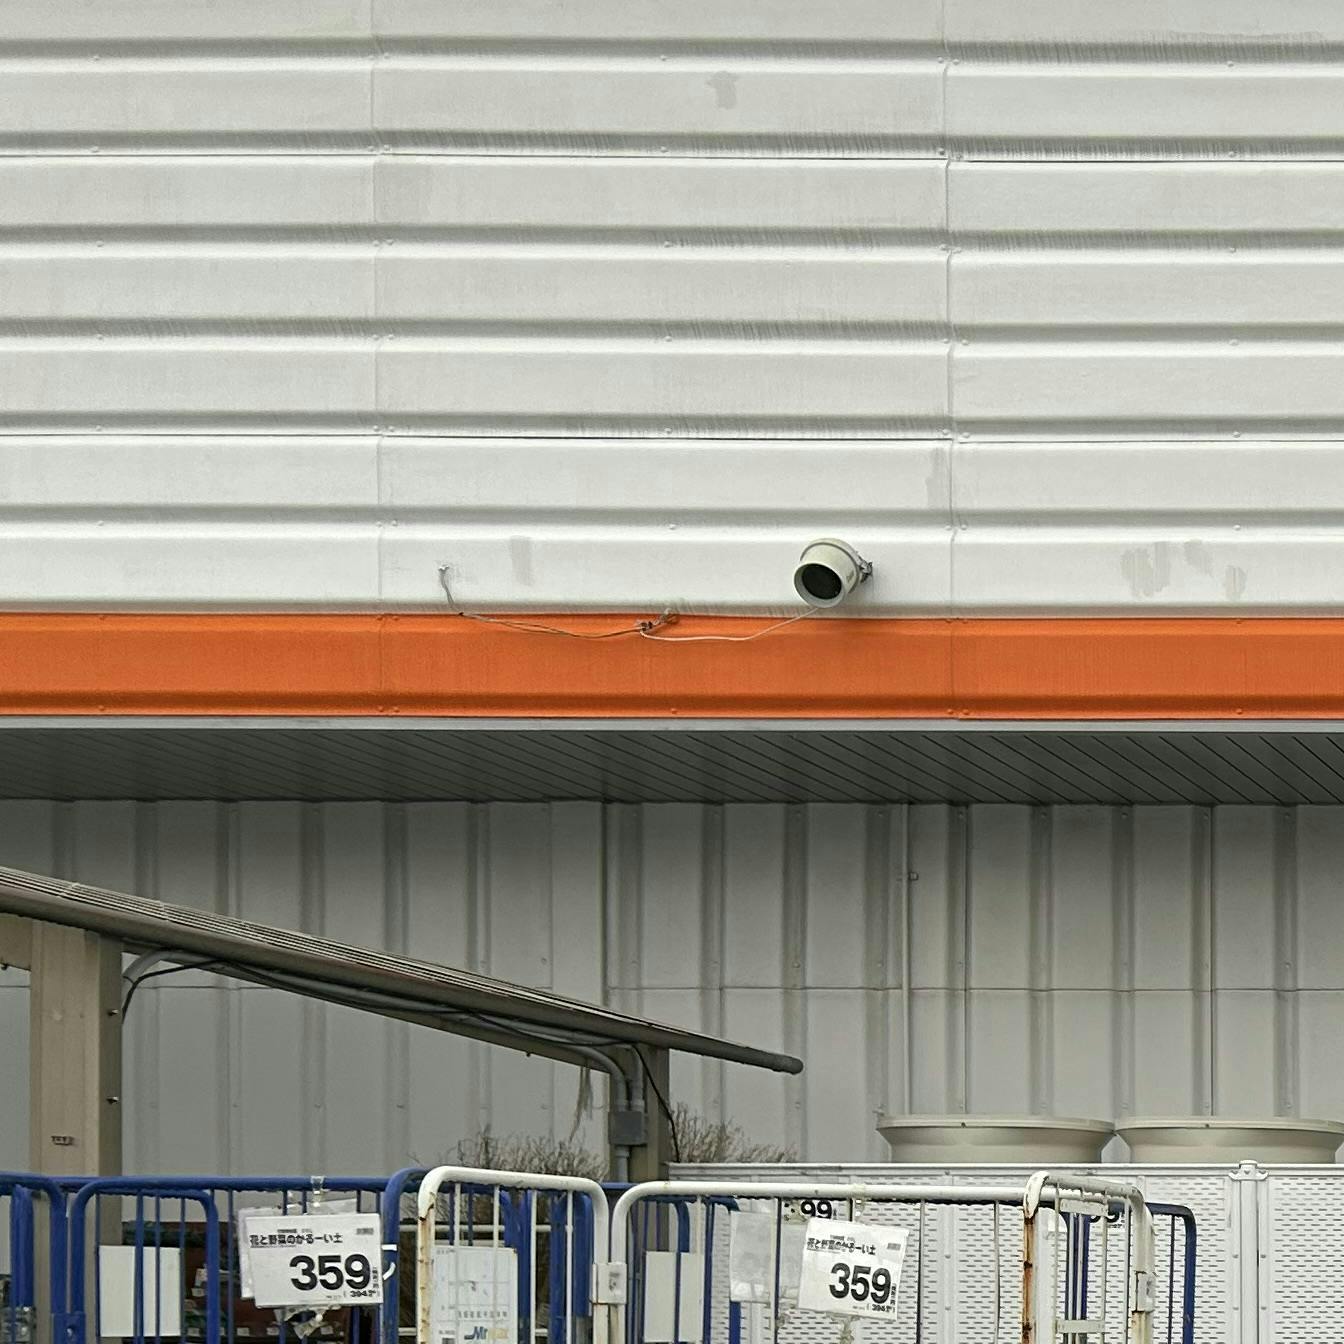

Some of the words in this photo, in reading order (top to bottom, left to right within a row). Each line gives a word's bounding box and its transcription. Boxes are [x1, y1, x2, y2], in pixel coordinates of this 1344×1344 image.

[801, 1199, 832, 1219] 99
[289, 1253, 371, 1291] 359
[829, 1262, 891, 1304] 359
